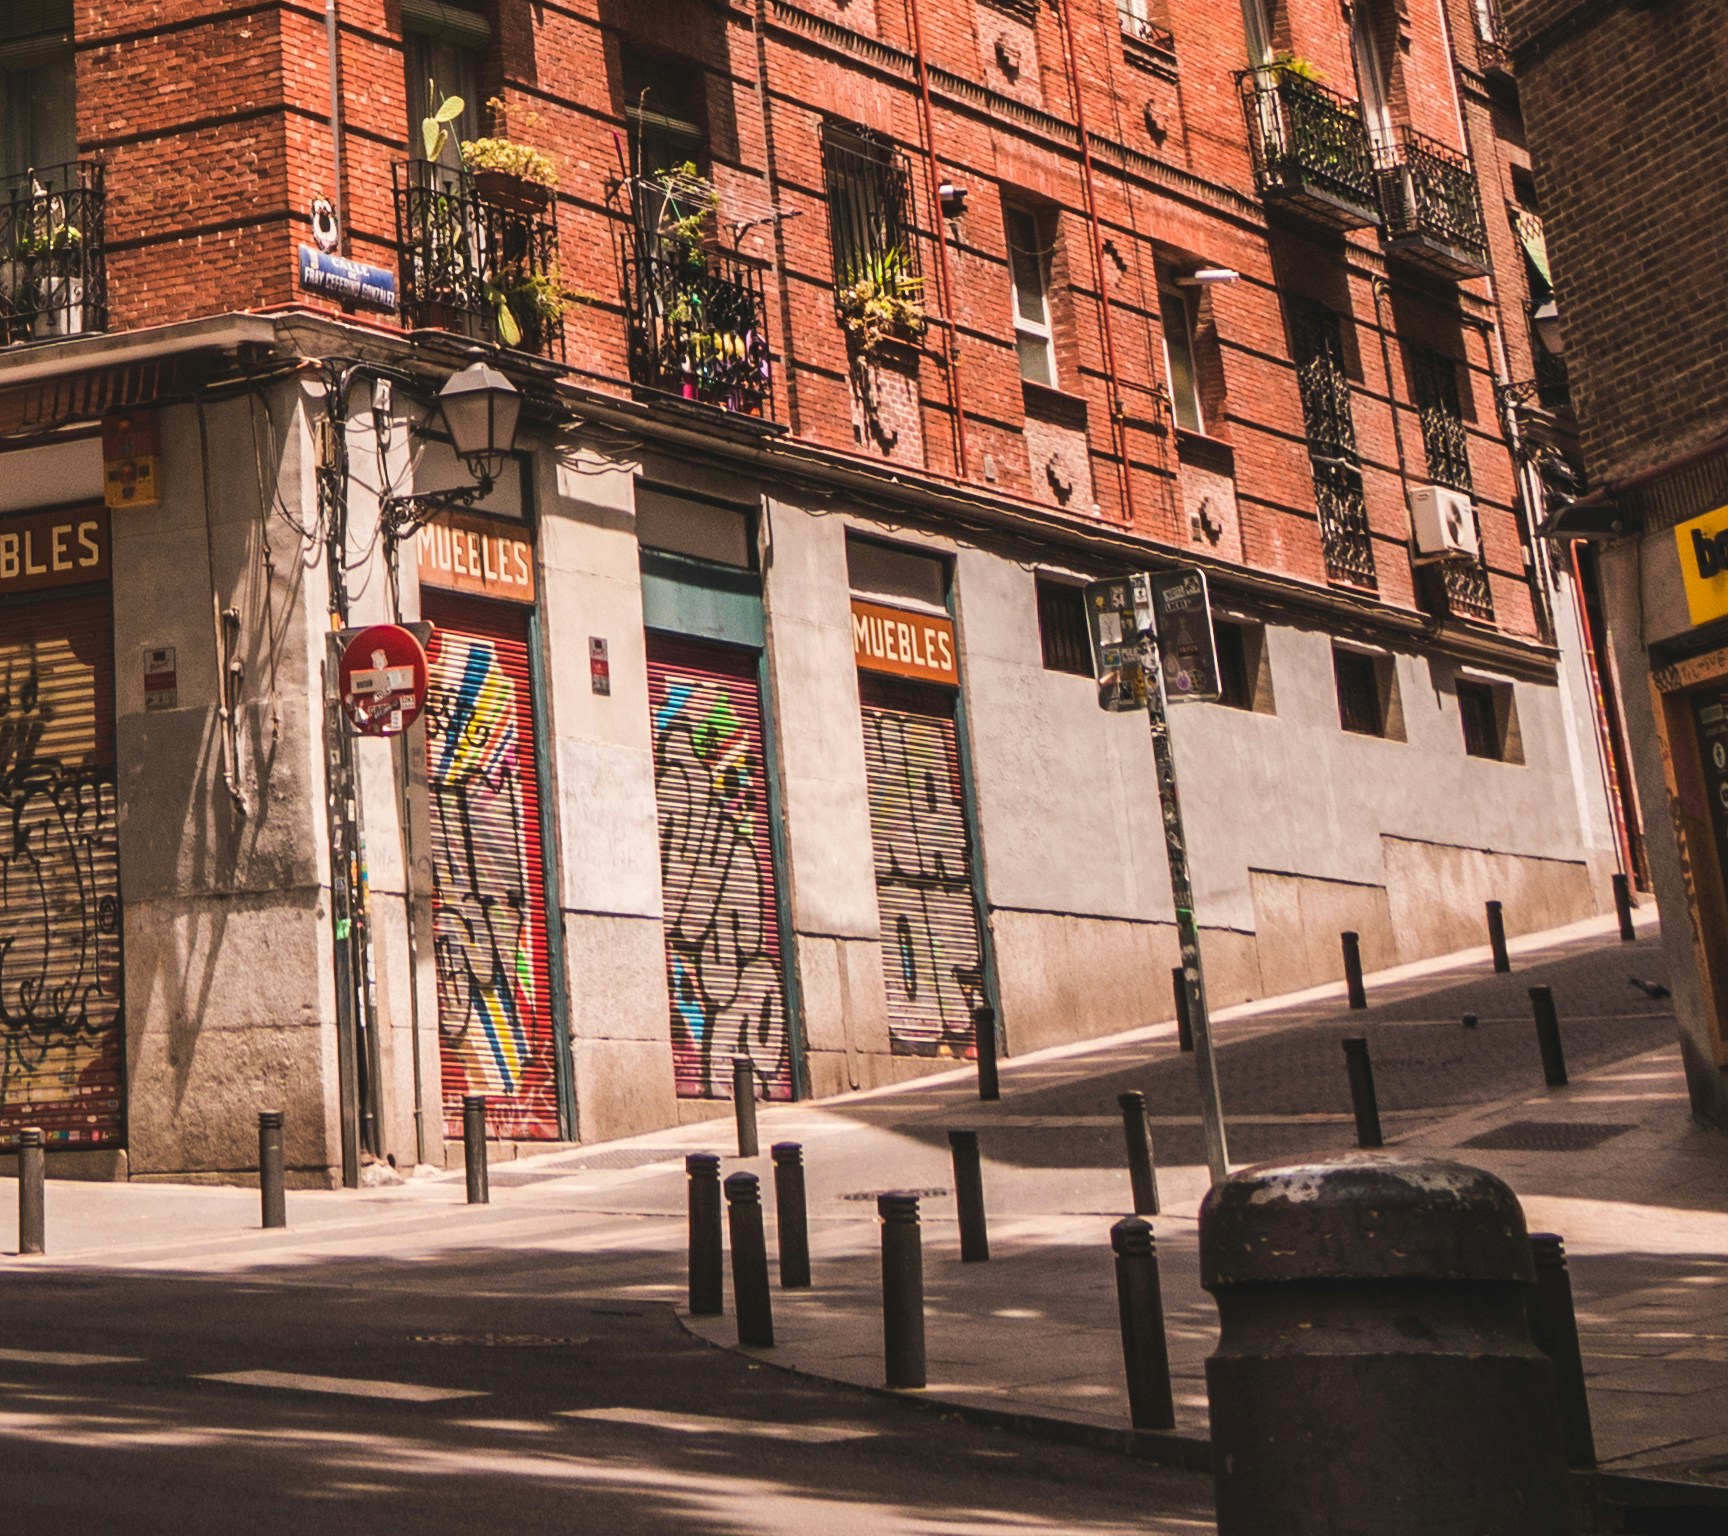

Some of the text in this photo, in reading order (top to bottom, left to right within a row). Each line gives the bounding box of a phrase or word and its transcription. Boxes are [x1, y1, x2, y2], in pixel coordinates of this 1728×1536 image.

[304, 266, 325, 286] FRAY
[331, 256, 370, 277] CALLE
[416, 522, 529, 586] MUEBLES
[852, 612, 952, 671] MUEBLES
